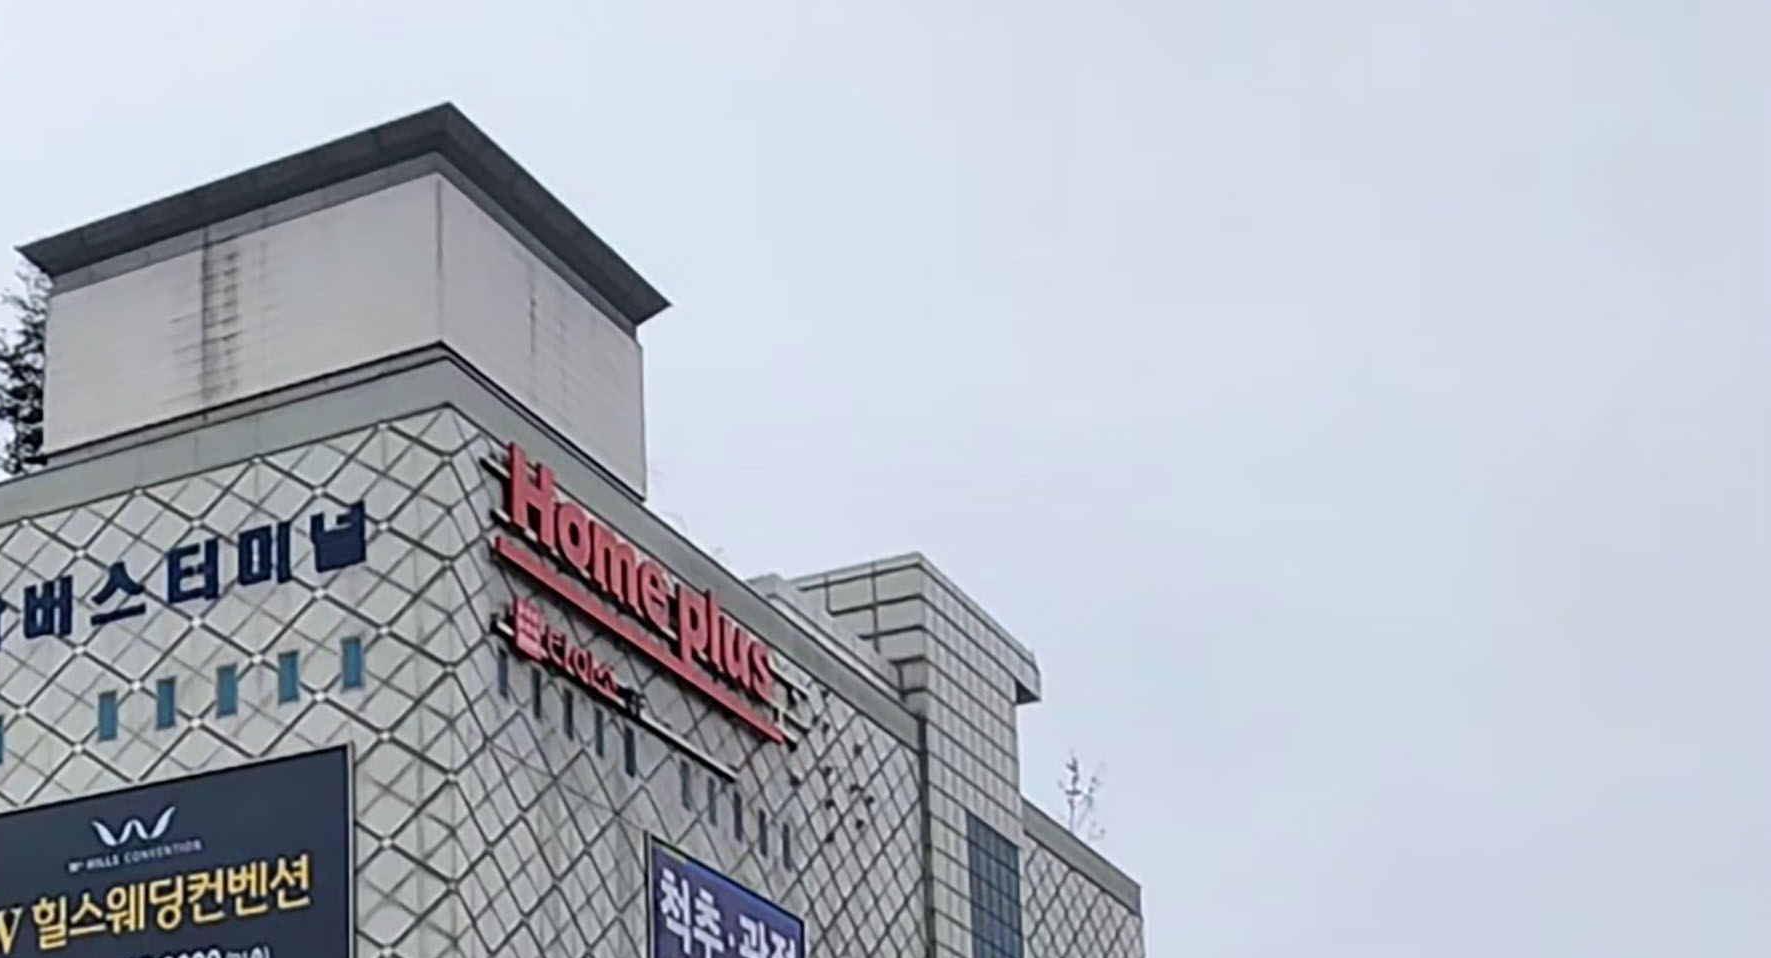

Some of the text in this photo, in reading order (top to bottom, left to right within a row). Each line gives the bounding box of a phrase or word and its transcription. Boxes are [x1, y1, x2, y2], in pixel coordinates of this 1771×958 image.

[510, 442, 773, 702] Home plus
[32, 853, 311, 950] 힐스웨딩컨벤션
